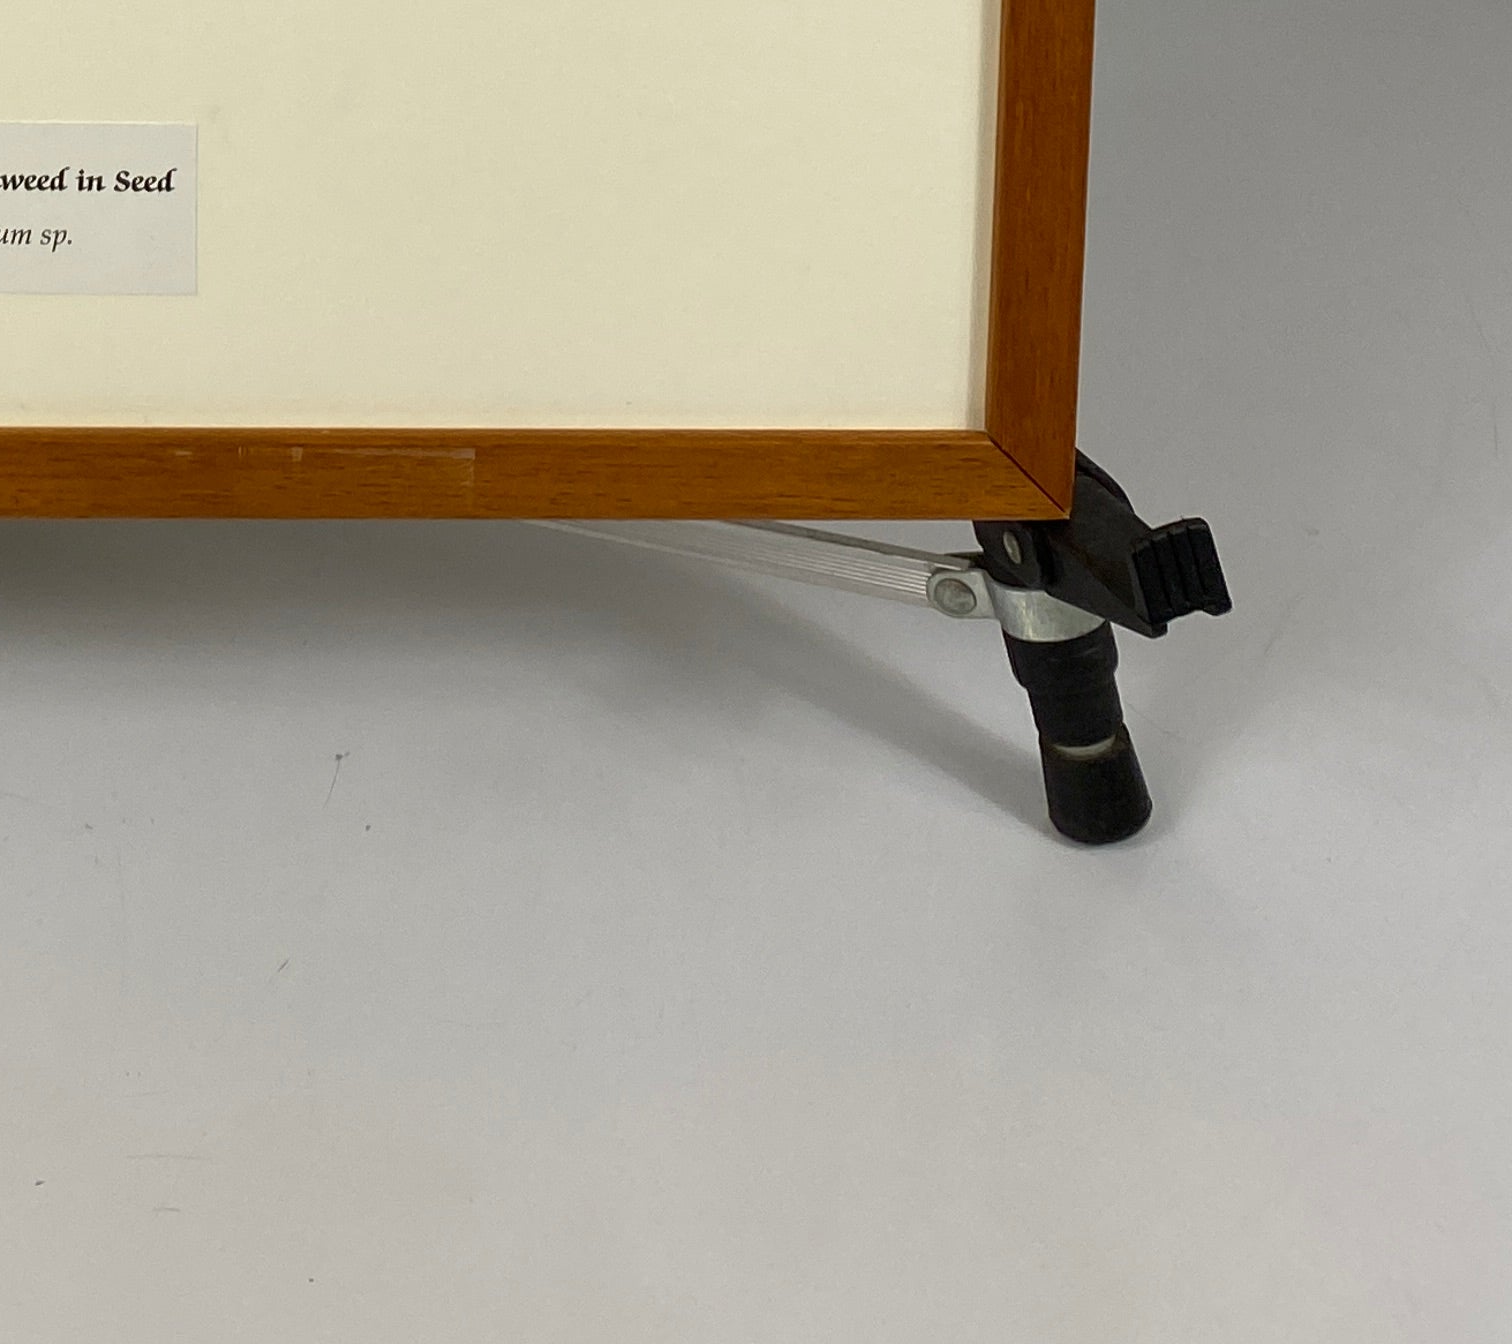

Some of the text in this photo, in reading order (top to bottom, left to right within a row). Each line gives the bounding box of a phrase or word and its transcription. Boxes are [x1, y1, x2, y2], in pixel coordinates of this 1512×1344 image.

[76, 168, 106, 192] in
[113, 167, 178, 193] Seed
[39, 229, 74, 253] sp.
